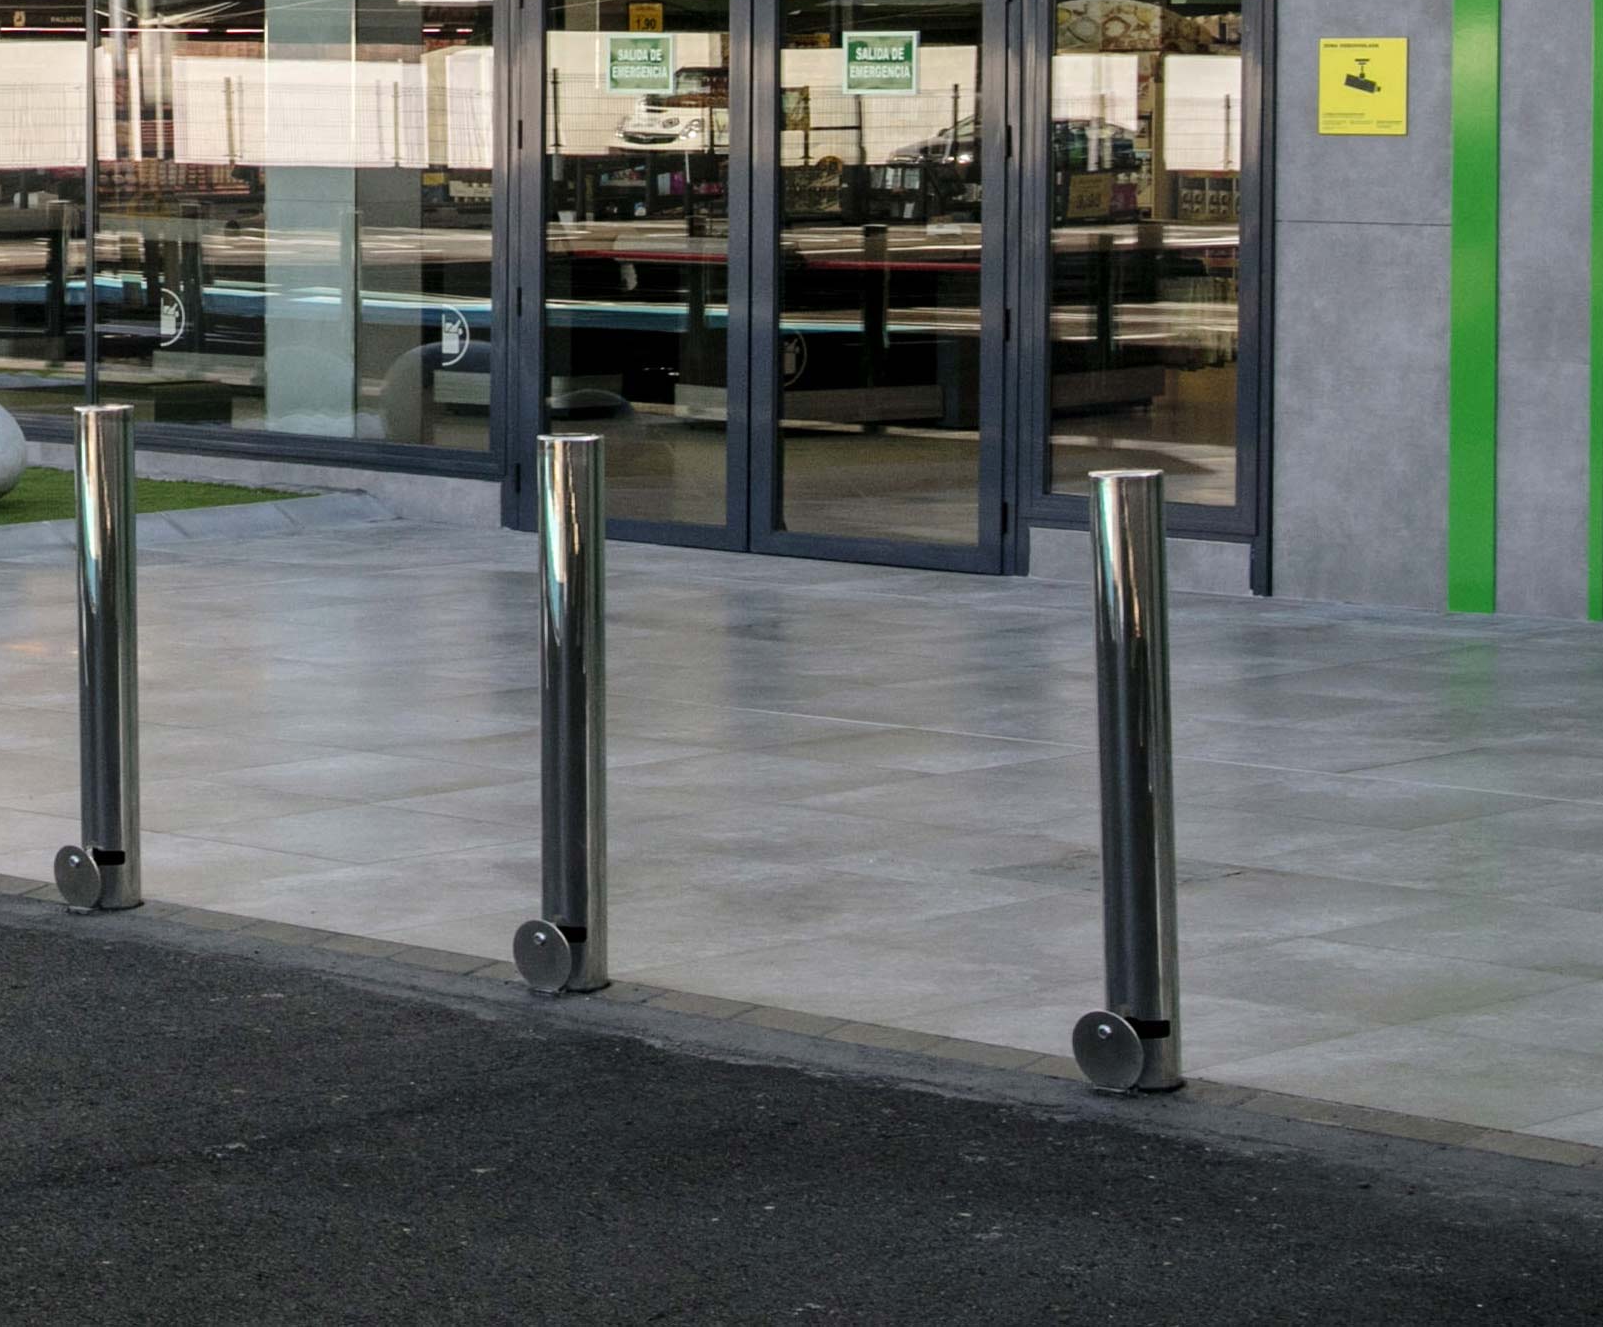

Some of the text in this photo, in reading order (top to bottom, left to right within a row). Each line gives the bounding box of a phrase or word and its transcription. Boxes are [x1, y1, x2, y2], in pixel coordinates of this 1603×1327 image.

[617, 48, 663, 62] SALIDA DE
[855, 47, 905, 61] SALIDA DE
[611, 65, 668, 79] EMERGENCIA
[849, 65, 911, 79] EMERGENCIA
